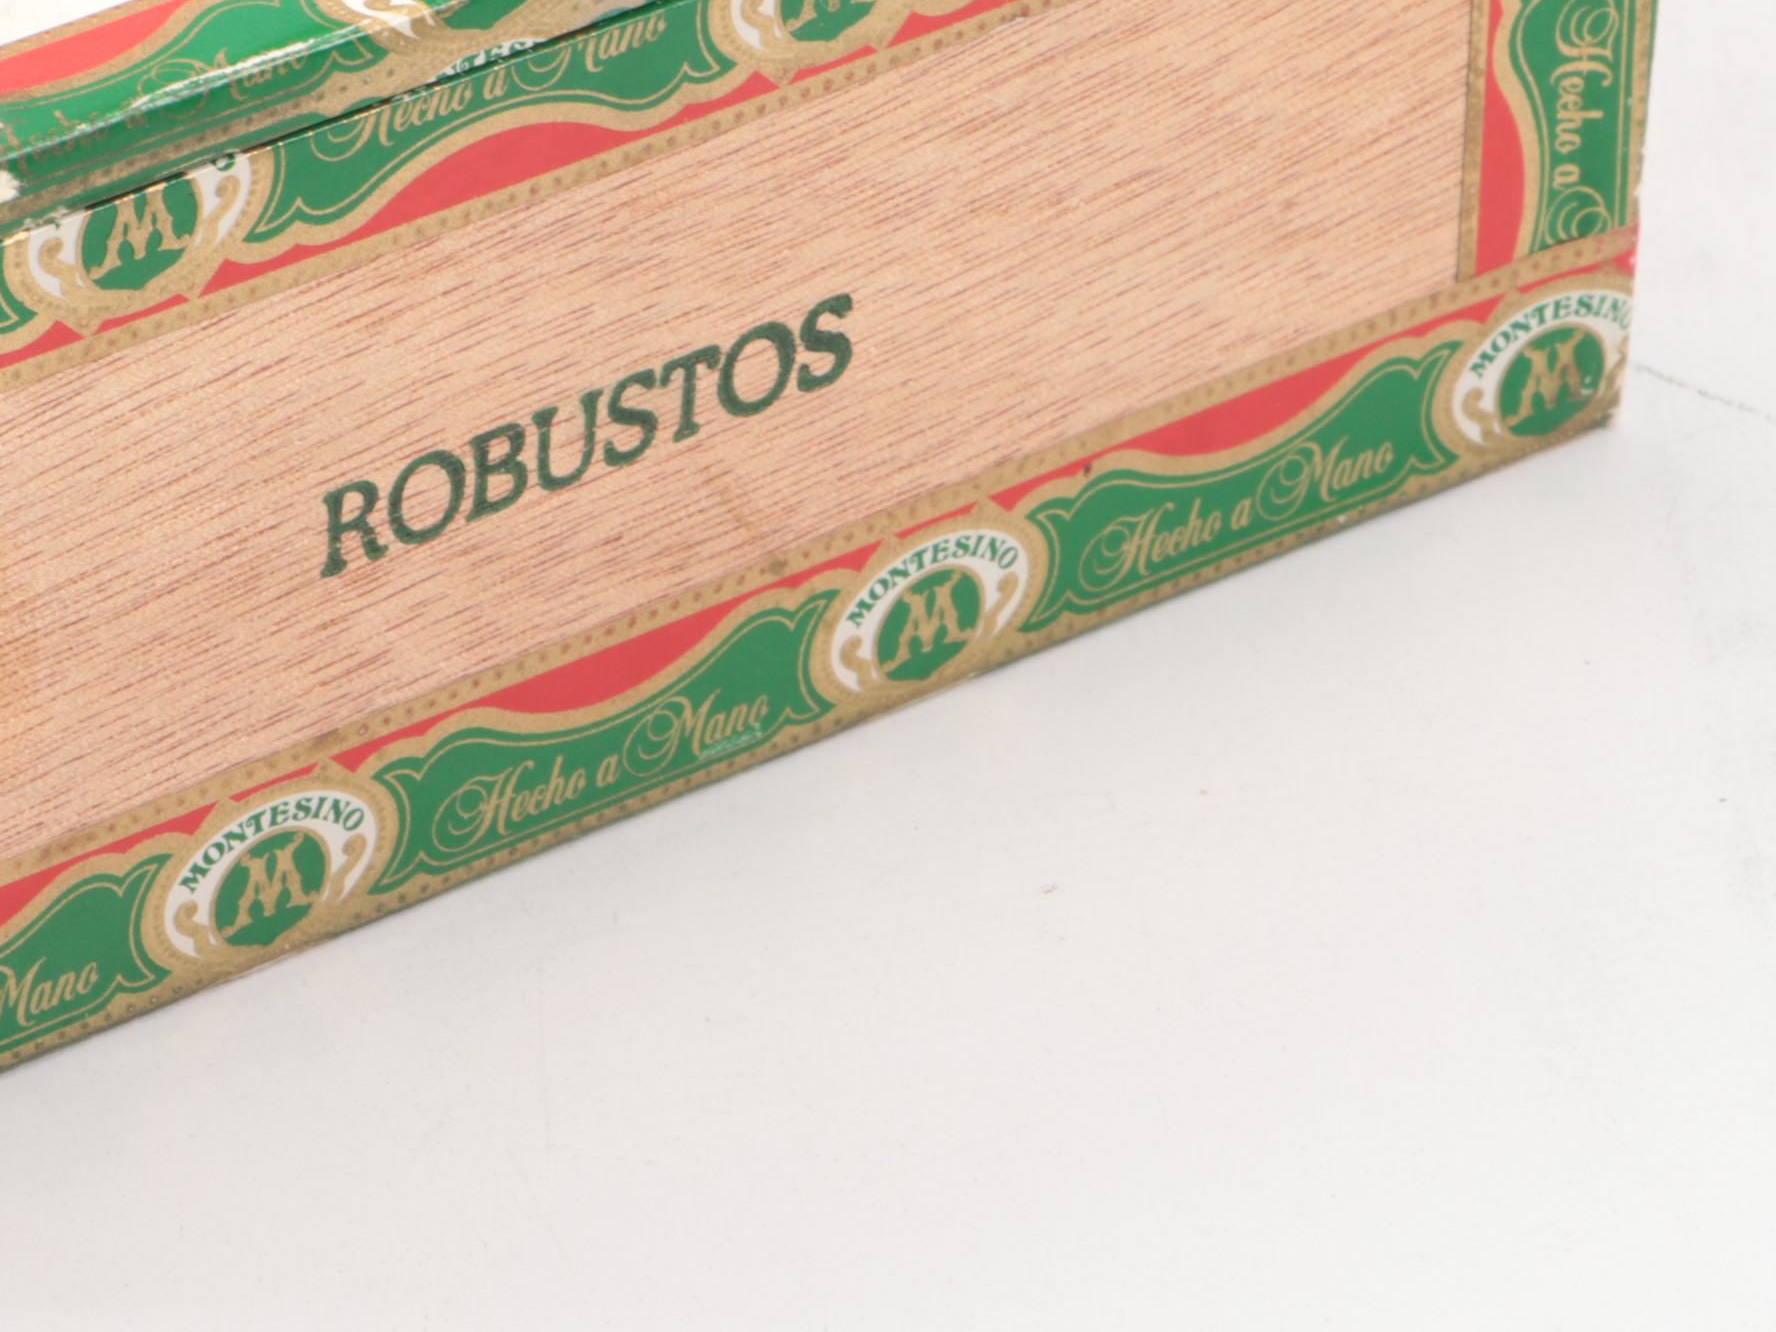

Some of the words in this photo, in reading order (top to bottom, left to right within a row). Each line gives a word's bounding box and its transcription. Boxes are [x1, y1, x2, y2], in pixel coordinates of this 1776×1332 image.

[1552, 164, 1582, 192] a
[319, 292, 854, 579] ROBUSTOS
[1077, 498, 1224, 591] Hecho
[1230, 498, 1255, 529] a
[1255, 436, 1396, 522] Mano
[847, 531, 1020, 630] MONTESINO
[430, 756, 587, 854] Hecho
[593, 756, 620, 789] a
[623, 692, 770, 778] Mano
[180, 795, 367, 896] MONTESINO
